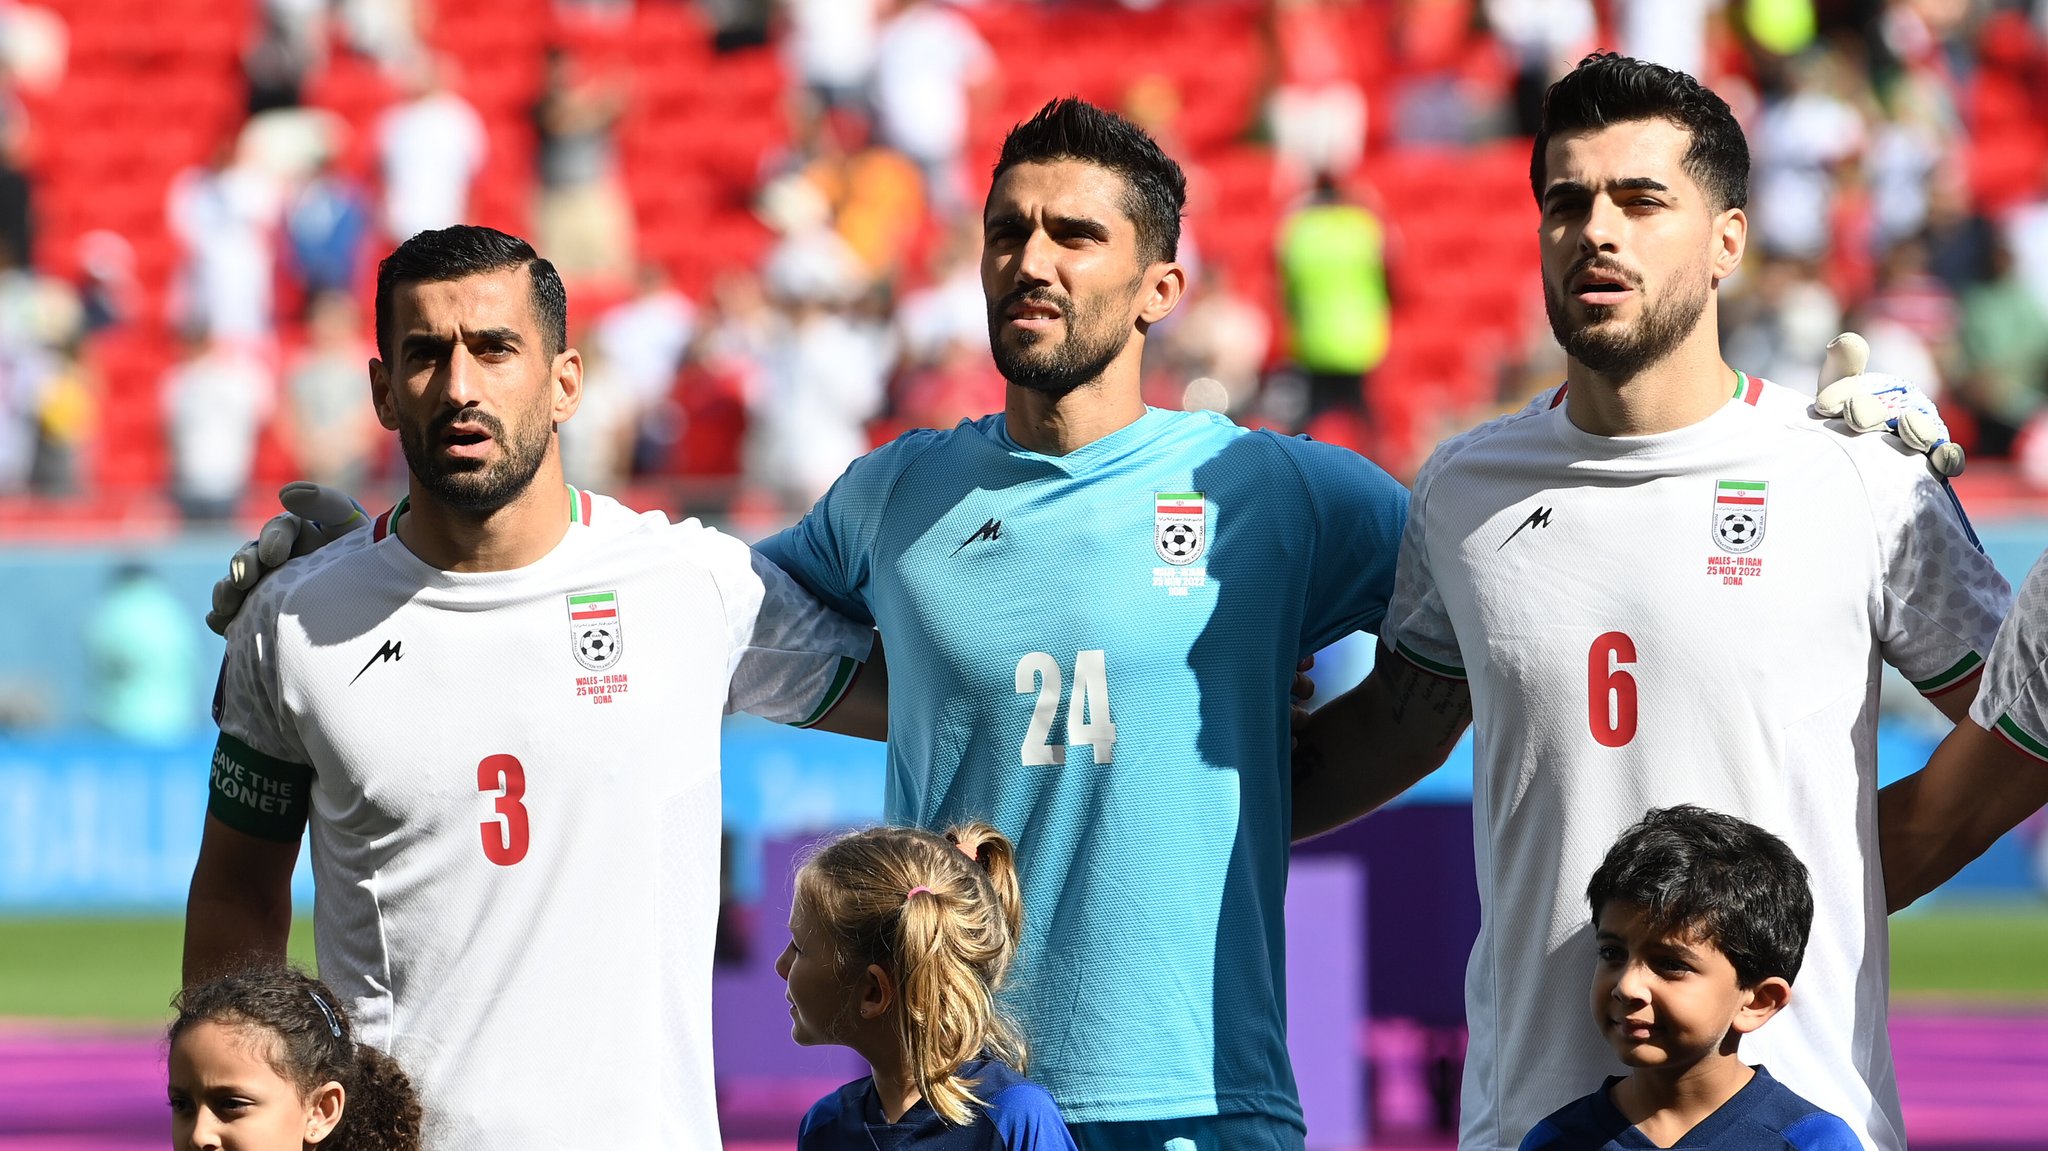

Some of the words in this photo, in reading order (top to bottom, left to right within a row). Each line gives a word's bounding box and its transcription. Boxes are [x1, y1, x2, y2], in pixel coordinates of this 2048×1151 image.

[1708, 556, 1731, 565] WALES
[1736, 557, 1744, 566] IR
[1745, 557, 1762, 567] IRAN
[1706, 566, 1718, 575] 25
[1719, 566, 1737, 575] NOV
[1738, 567, 1761, 577] 2022
[1723, 576, 1743, 586] DOHA
[576, 676, 598, 686] WALES
[603, 675, 611, 684] IR
[611, 674, 628, 683] IRAN
[576, 687, 587, 696] 25
[588, 685, 605, 695] NOV
[606, 683, 628, 694] 2022
[1588, 631, 1638, 747] 6
[593, 695, 612, 705] DOHA
[1015, 649, 1117, 766] 24
[214, 746, 245, 782] SAVE
[249, 771, 292, 797] THE
[211, 764, 292, 816] PLANET
[477, 753, 530, 866] 3
